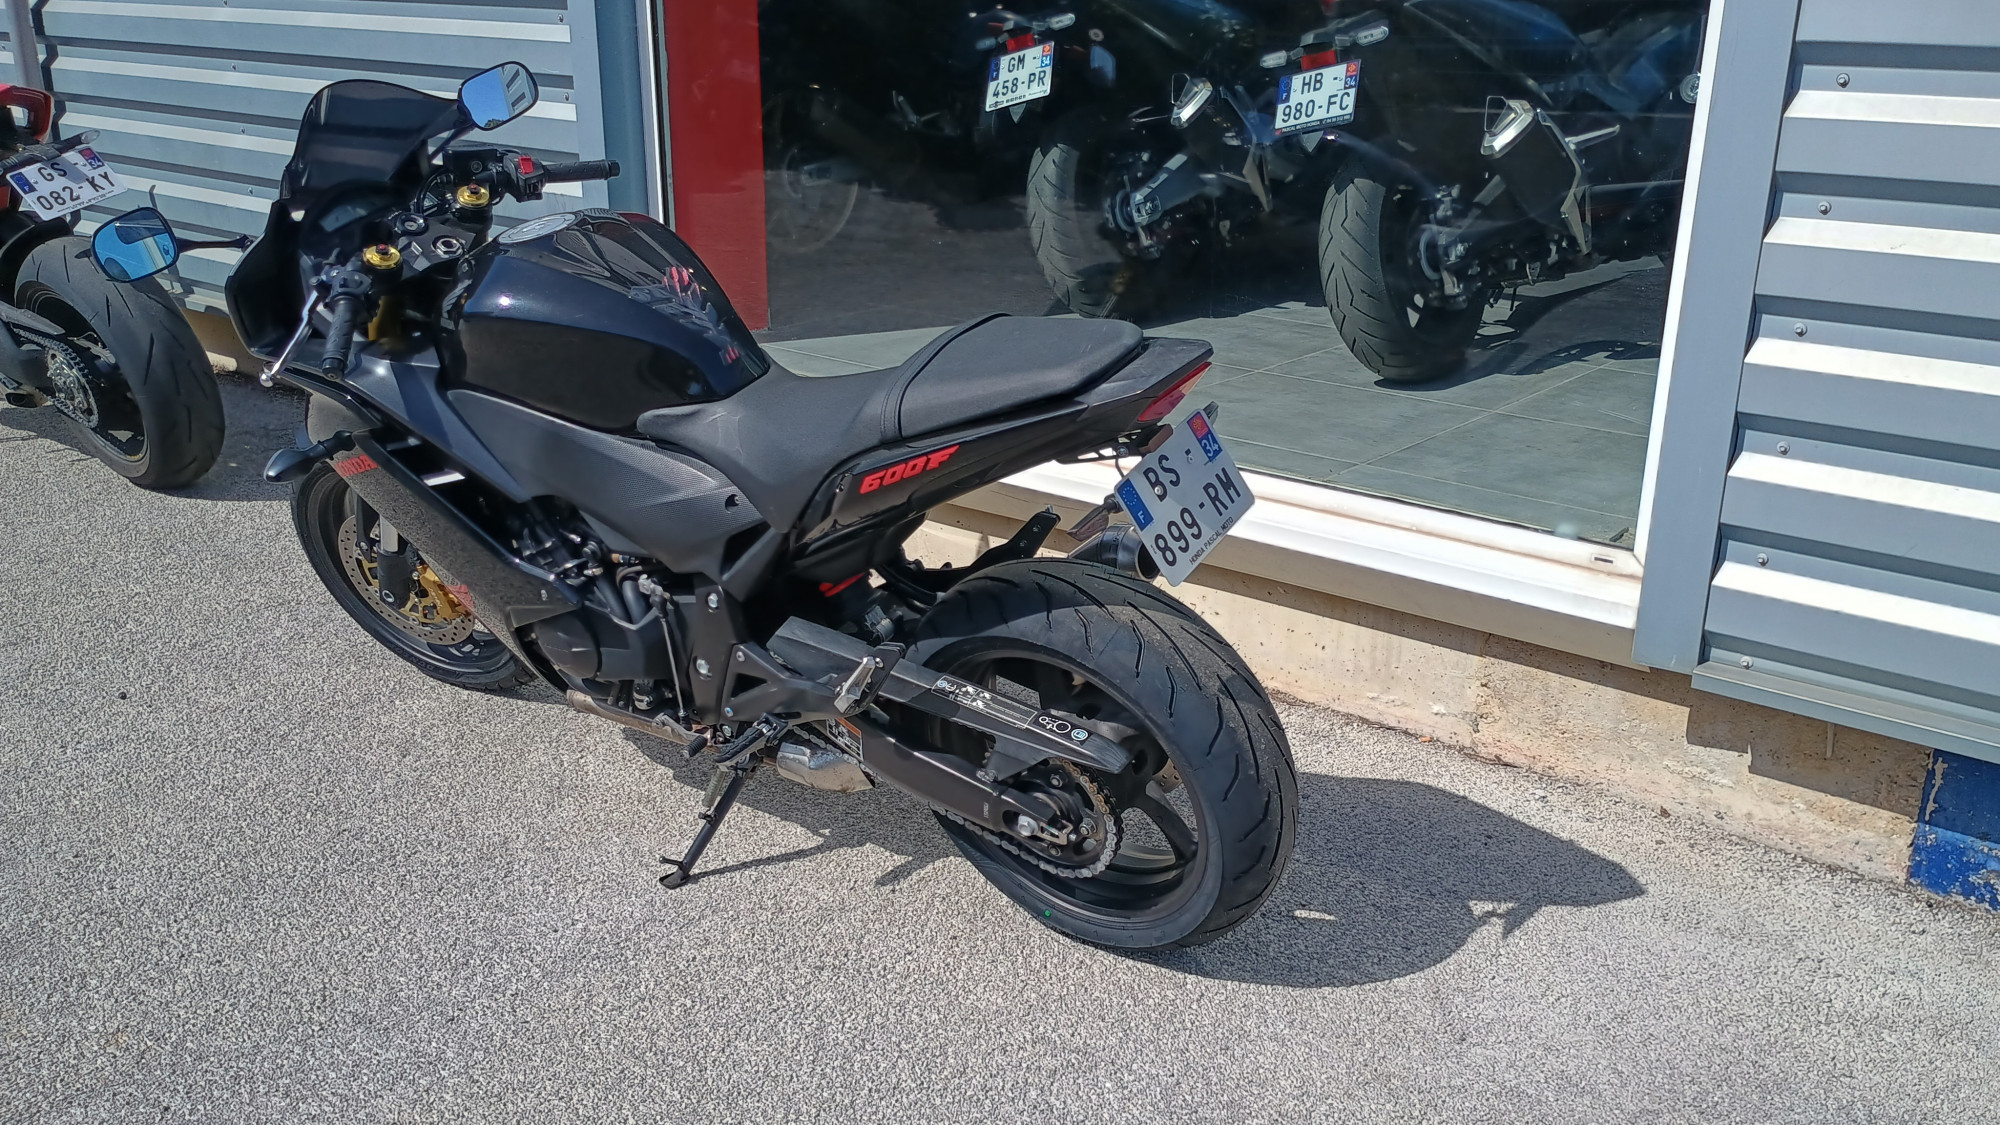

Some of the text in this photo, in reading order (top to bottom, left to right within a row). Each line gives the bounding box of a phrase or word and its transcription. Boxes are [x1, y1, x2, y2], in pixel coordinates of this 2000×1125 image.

[1007, 53, 1026, 73] GM
[1041, 57, 1050, 66] 34
[992, 70, 1047, 98] 458-PR
[1300, 72, 1324, 95] HB
[1345, 77, 1356, 88] 34
[1281, 92, 1351, 123] 980-FC
[37, 162, 68, 182] GS
[88, 158, 102, 168] 34
[37, 171, 115, 211] 082-KY
[1201, 433, 1219, 458] 34
[860, 444, 960, 495] 600F
[1143, 454, 1181, 502] BS
[1137, 510, 1145, 524] F
[1154, 467, 1242, 568] 899-RM
[1188, 515, 1235, 565] HONDA PASCAL MOTO
